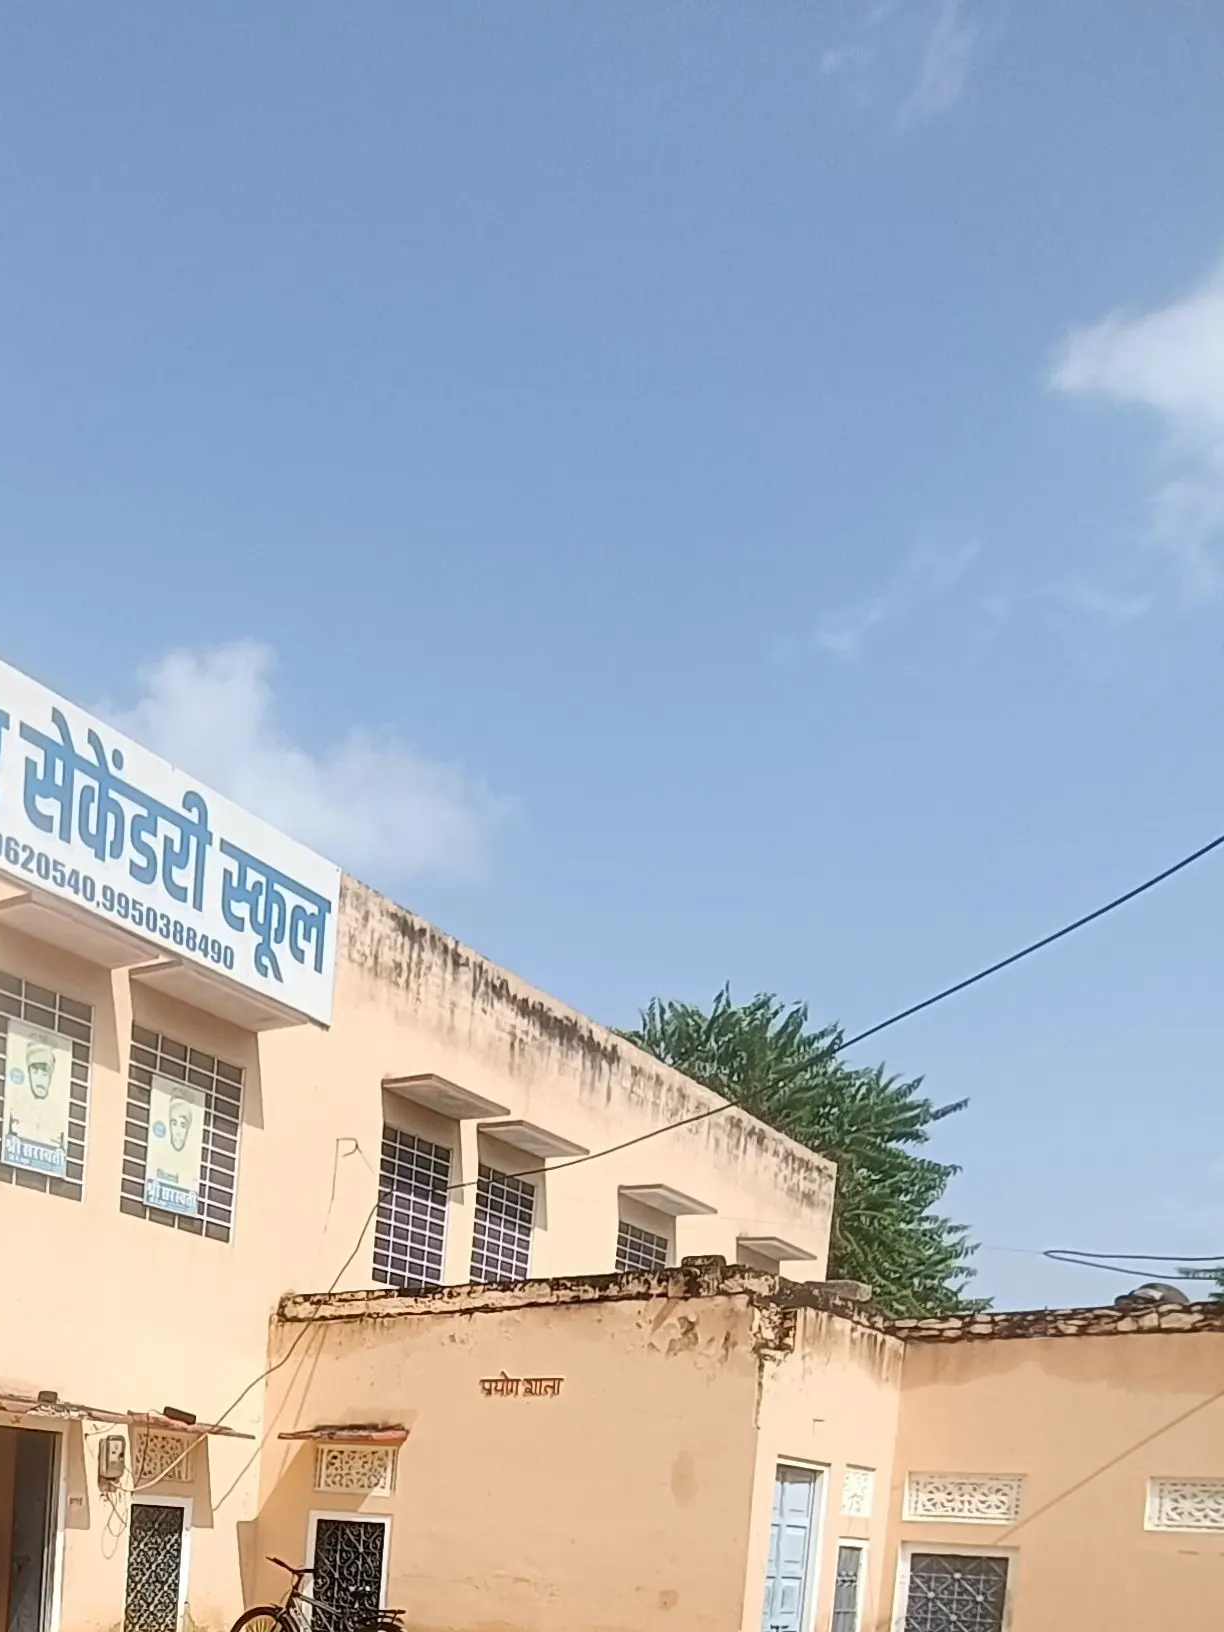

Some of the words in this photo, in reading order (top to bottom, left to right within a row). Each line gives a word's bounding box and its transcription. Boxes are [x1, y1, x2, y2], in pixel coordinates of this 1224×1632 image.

[19, 706, 214, 912] सेकेंडरी
[219, 837, 332, 984] स्कूल
[479, 1370, 522, 1398] प्रयोग
[523, 1377, 564, 1399] शाला
